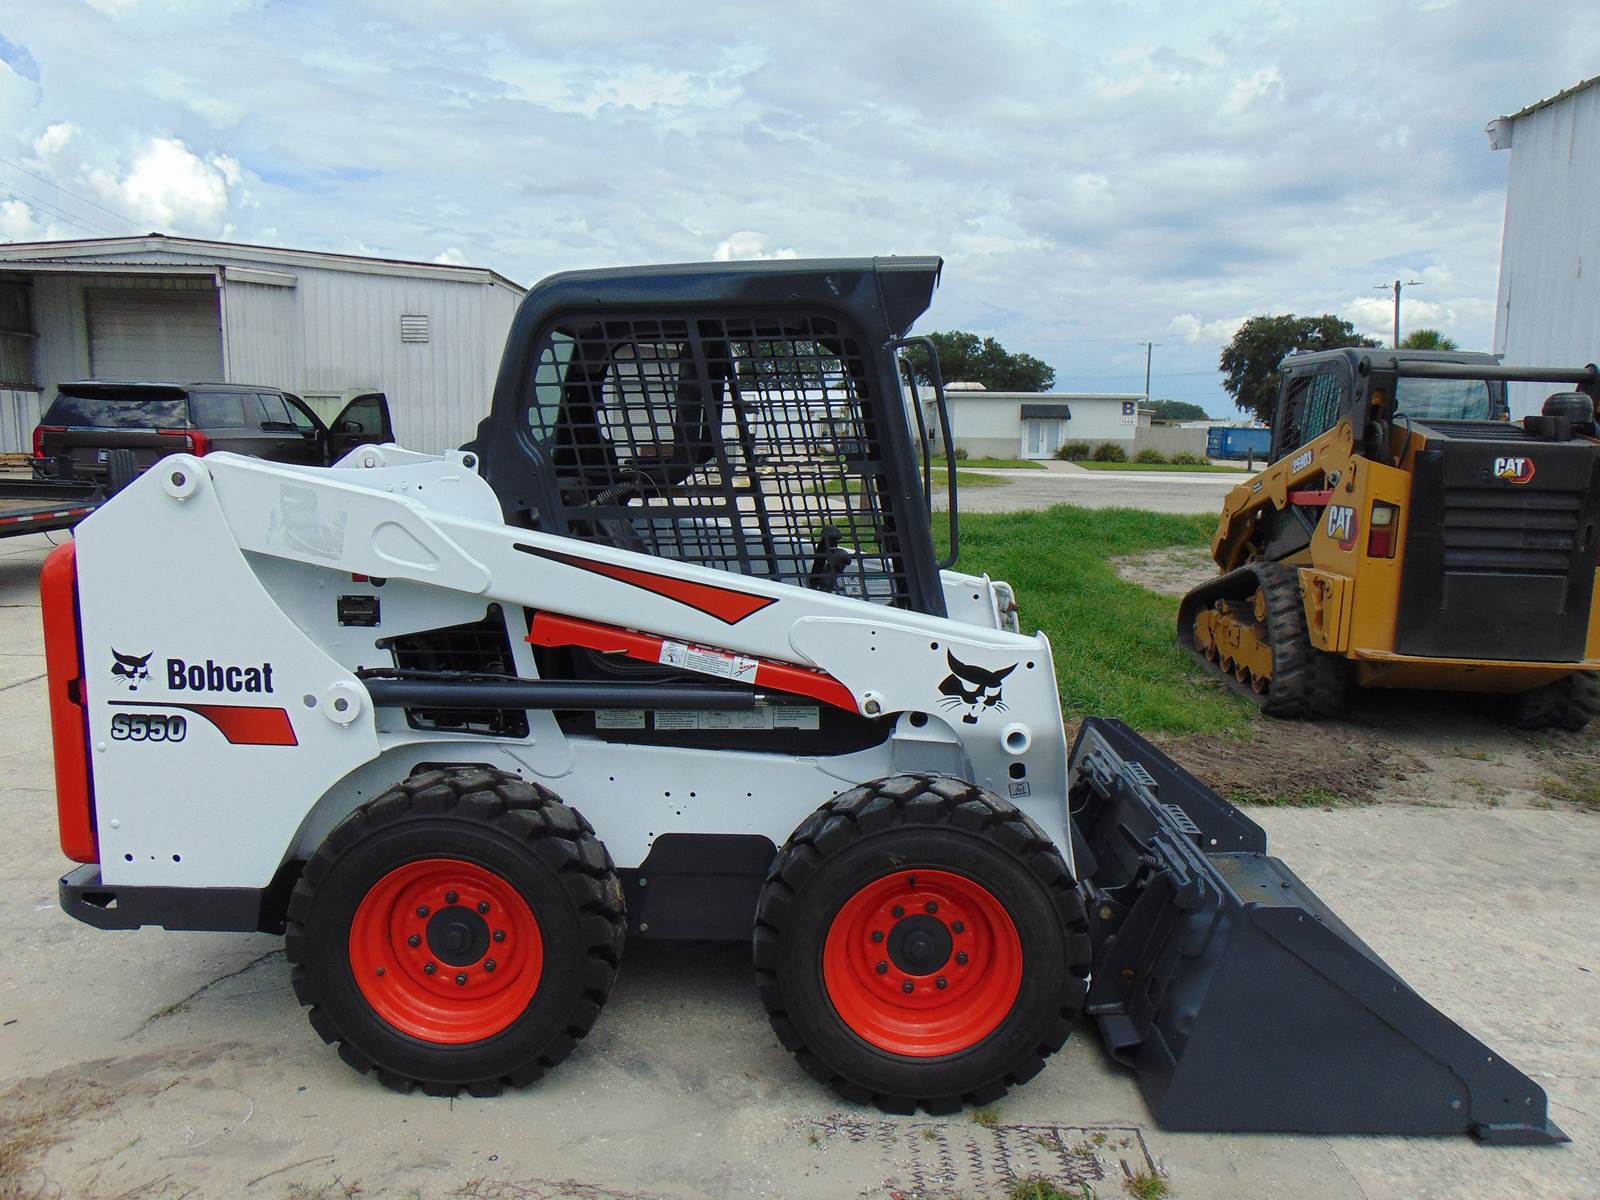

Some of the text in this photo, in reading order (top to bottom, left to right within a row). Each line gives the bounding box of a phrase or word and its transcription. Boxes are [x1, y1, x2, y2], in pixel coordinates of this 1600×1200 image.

[1494, 457, 1525, 477] CAT
[1328, 505, 1353, 540] CAT
[167, 659, 274, 693] Bobcat
[111, 713, 187, 742] S550
